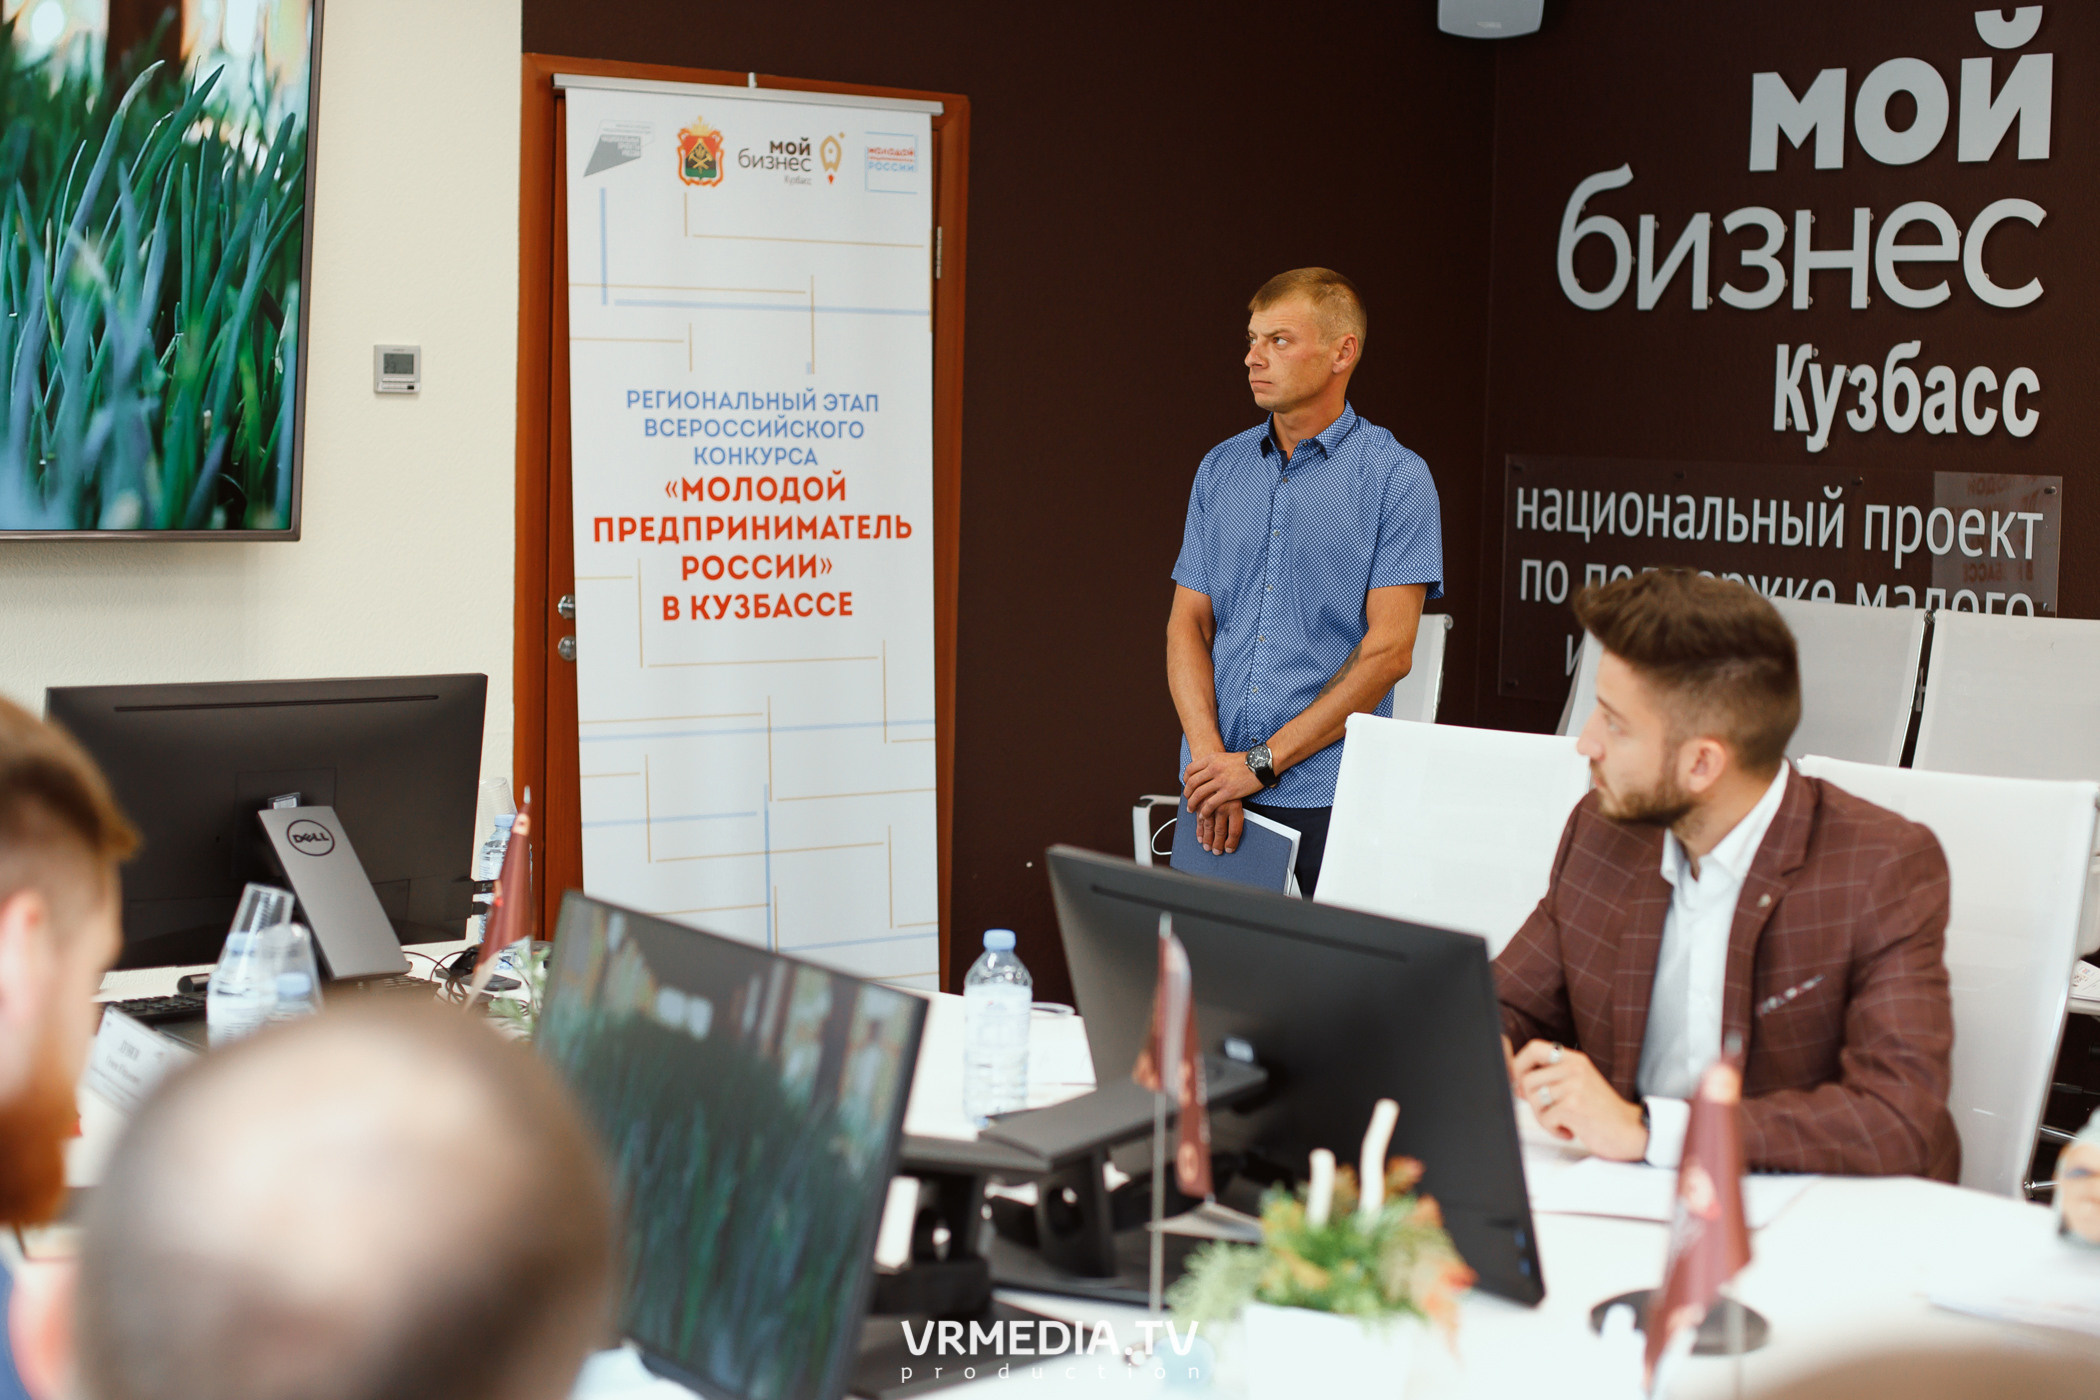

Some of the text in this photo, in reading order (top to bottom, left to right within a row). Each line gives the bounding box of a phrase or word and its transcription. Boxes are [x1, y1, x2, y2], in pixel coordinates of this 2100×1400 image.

[1750, 6, 2053, 172] мой
[738, 148, 811, 172] бизнес
[770, 137, 811, 156] мой
[1557, 163, 2047, 311] бизнес
[627, 388, 878, 412] РЕГИОНАЛЬНЫЙ ЭТАП
[1774, 340, 2041, 453] Кузбасс
[644, 415, 865, 439] ВСЕРОССИЙСКОГО
[694, 447, 818, 466] КОНКУРСА
[665, 470, 846, 504] «МОЛОДОЙ
[594, 515, 912, 544] ПРЕДПРИНИМАТЕЛЬ
[1517, 485, 2043, 569] национальный проект
[682, 554, 832, 581] РОССИИ»
[1520, 558, 1569, 604] по
[663, 592, 853, 620] В КУЗБАССЕ
[293, 833, 329, 843] DELL
